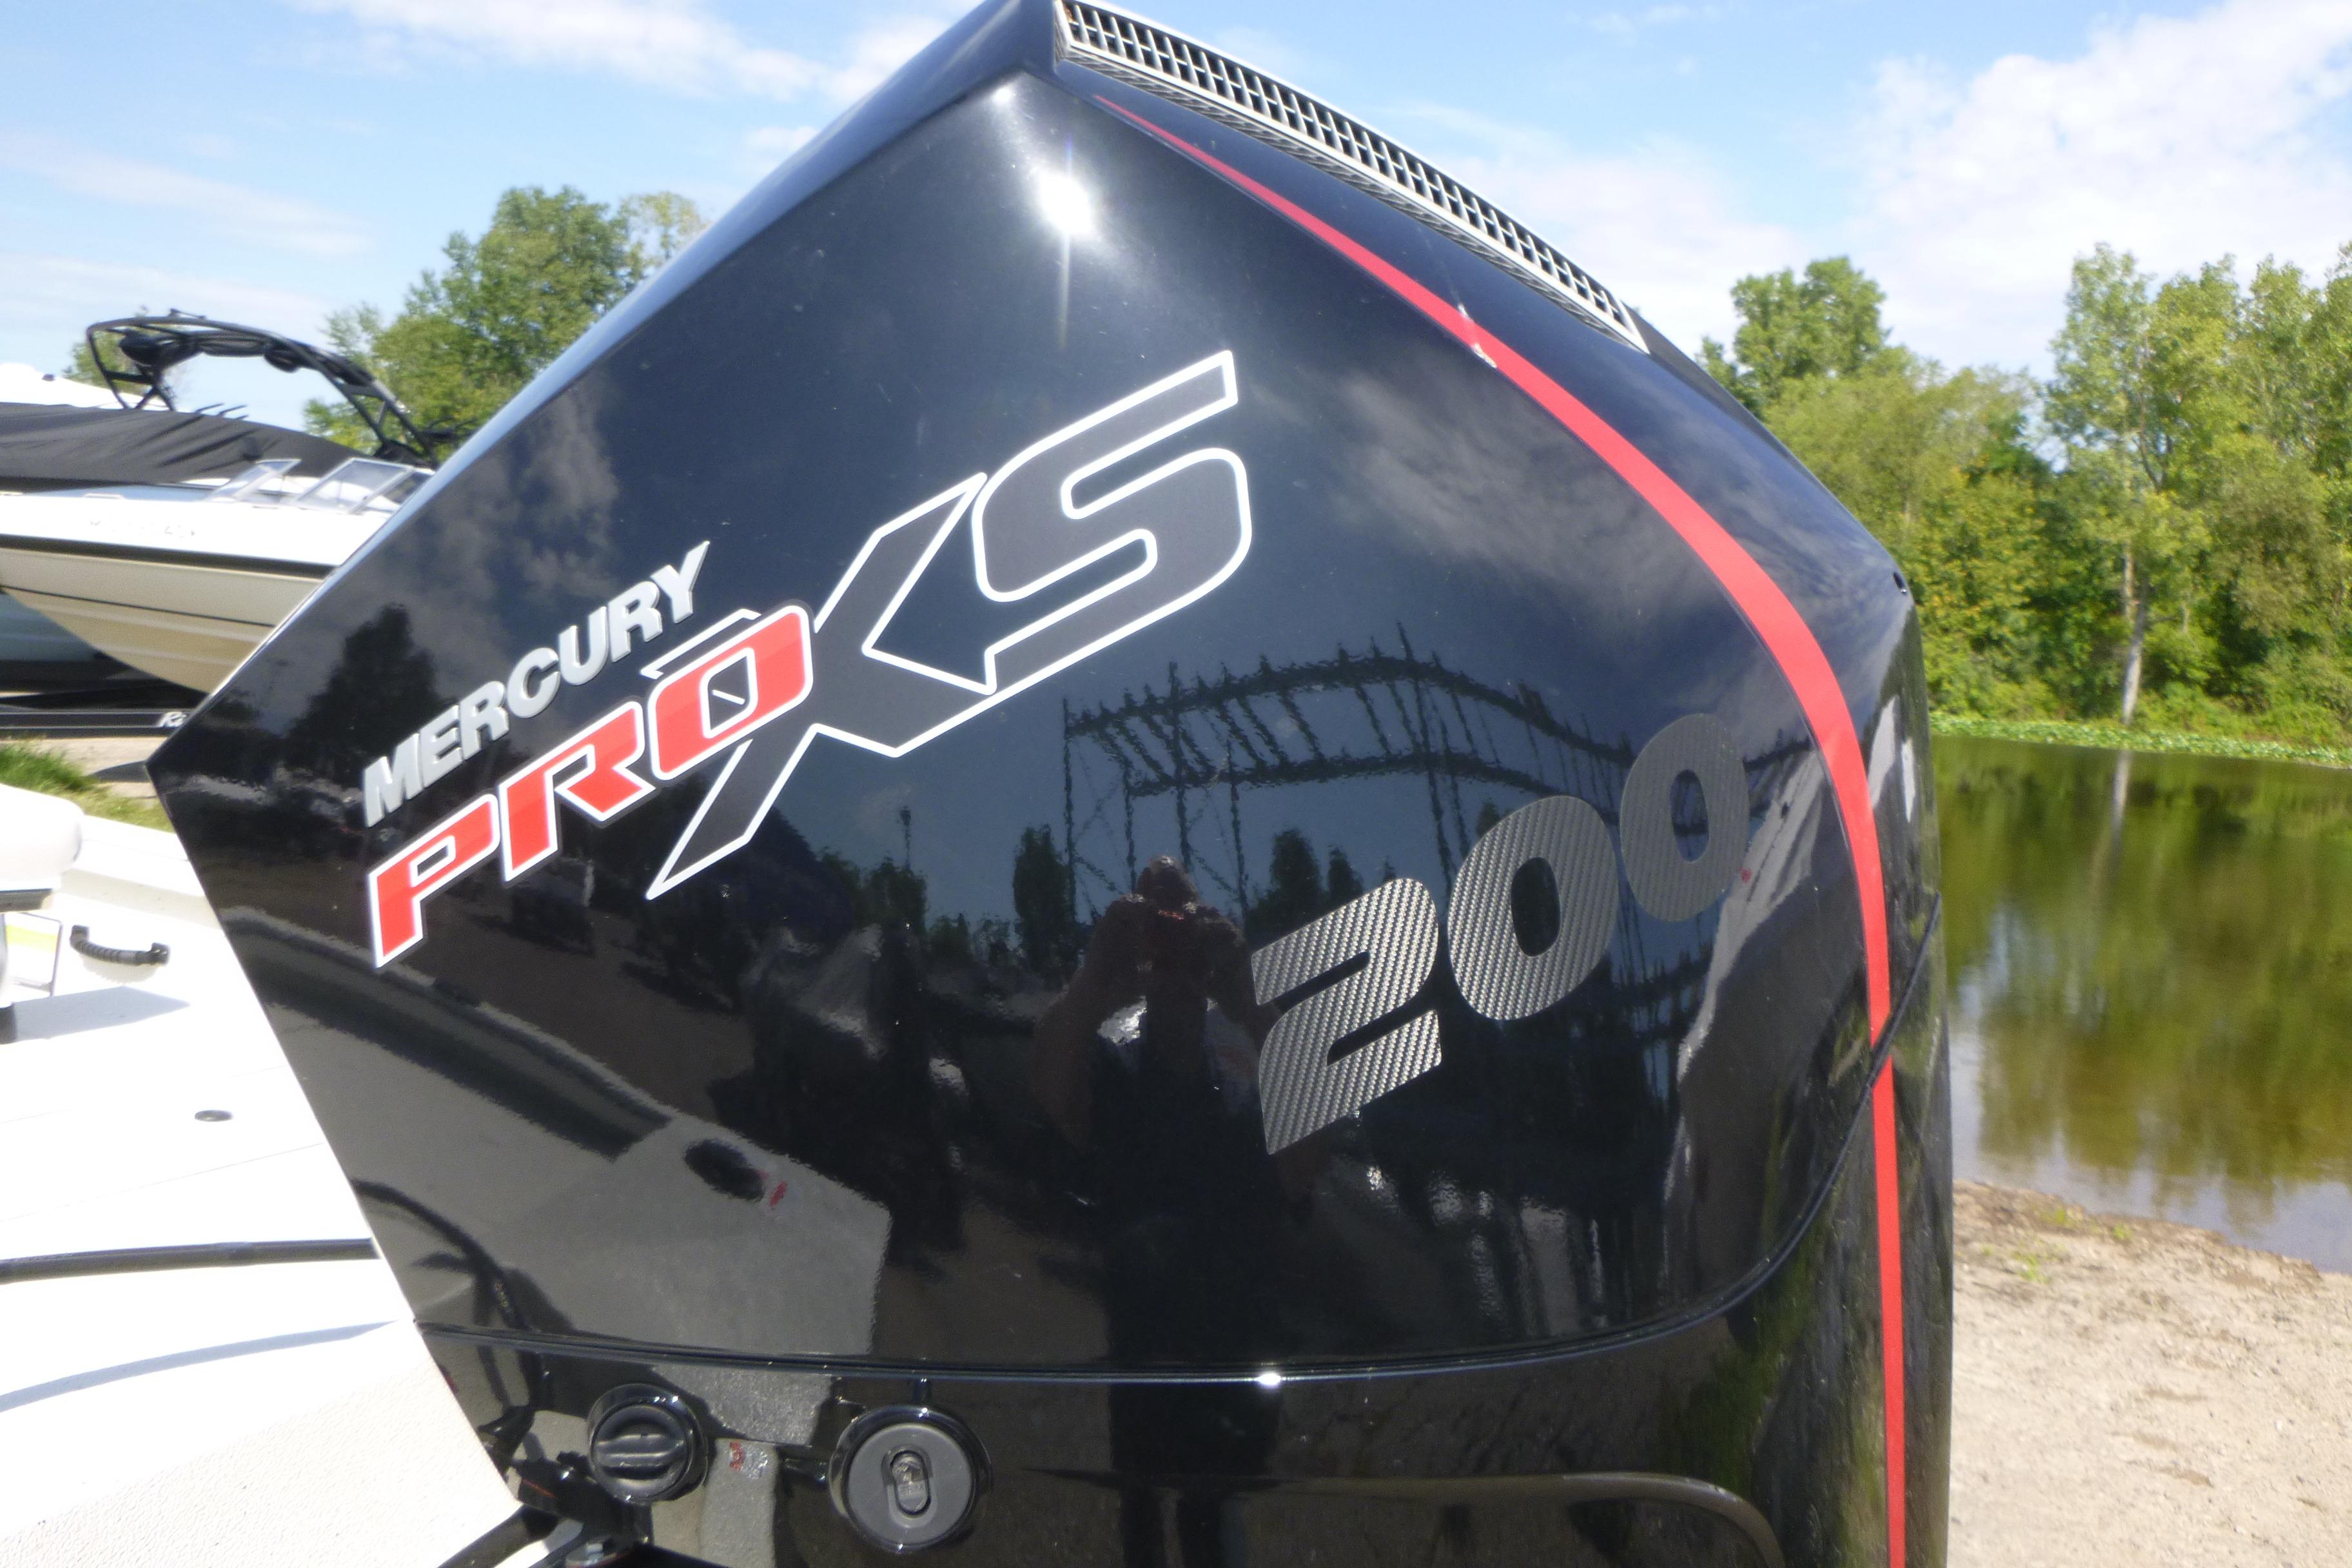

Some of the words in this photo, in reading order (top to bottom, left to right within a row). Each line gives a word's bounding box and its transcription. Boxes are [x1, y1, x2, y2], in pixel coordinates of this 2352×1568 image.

[363, 541, 709, 827] MERCURY
[369, 601, 814, 968] PRO
[1251, 712, 1750, 1155] 200
